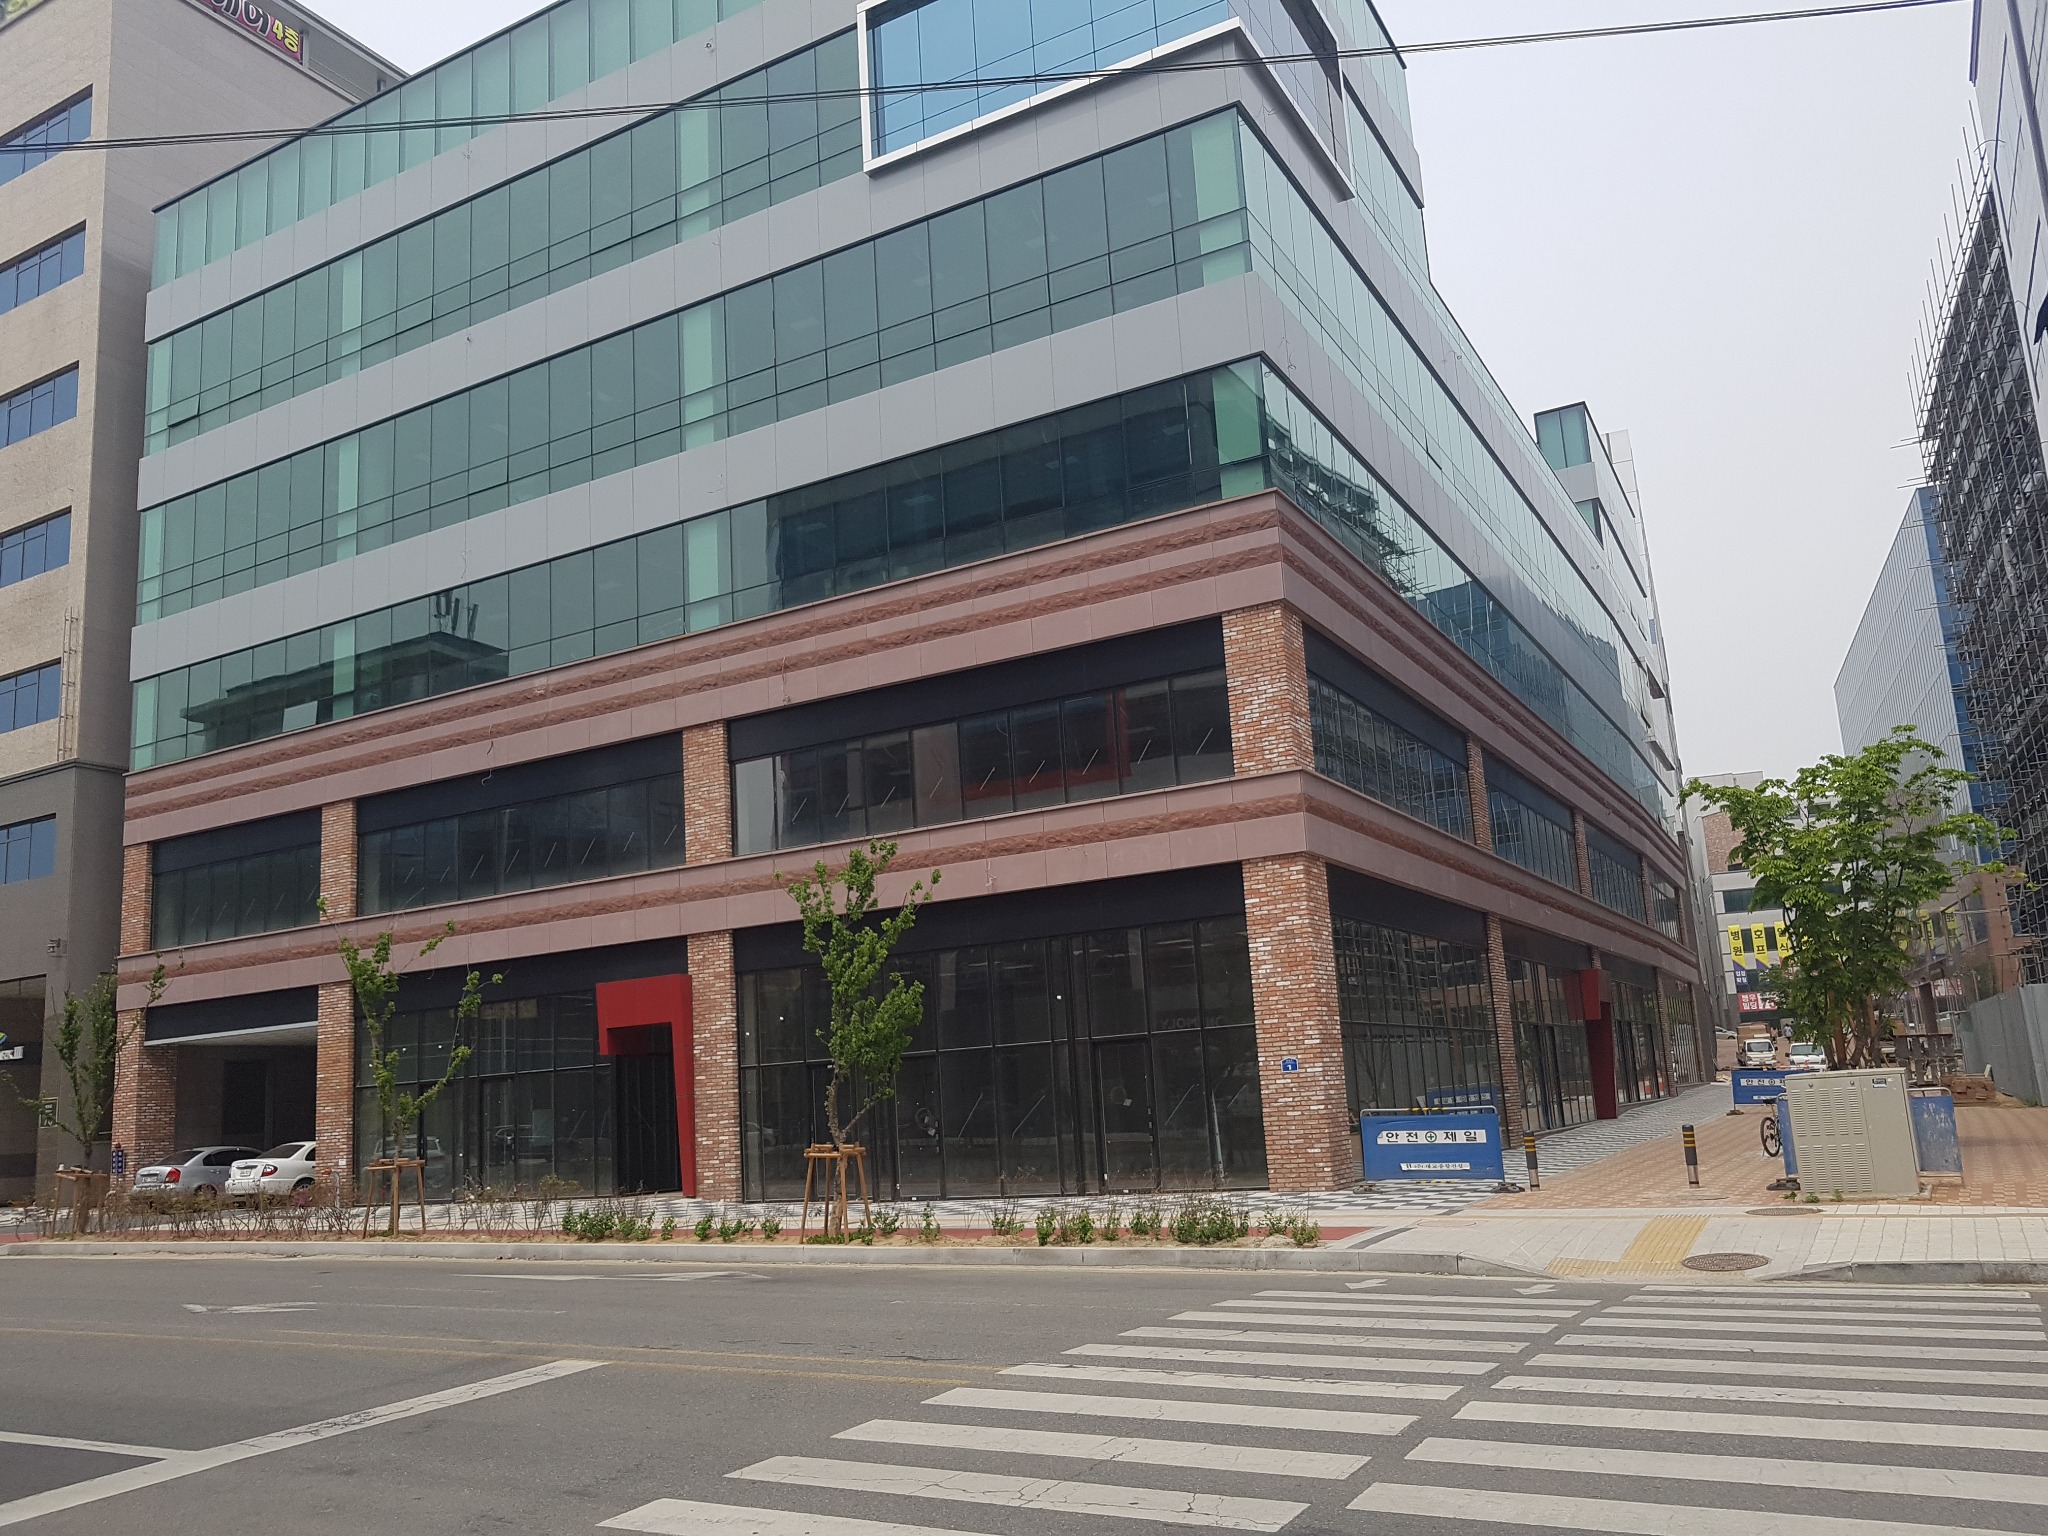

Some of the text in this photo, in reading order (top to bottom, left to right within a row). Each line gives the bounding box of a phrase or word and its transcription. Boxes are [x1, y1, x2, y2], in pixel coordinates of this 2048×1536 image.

[272, 19, 299, 53] 4층
[1730, 930, 1742, 956] 병원
[1753, 929, 1765, 954] 호프
[1385, 1130, 1478, 1143] 안전 제일
